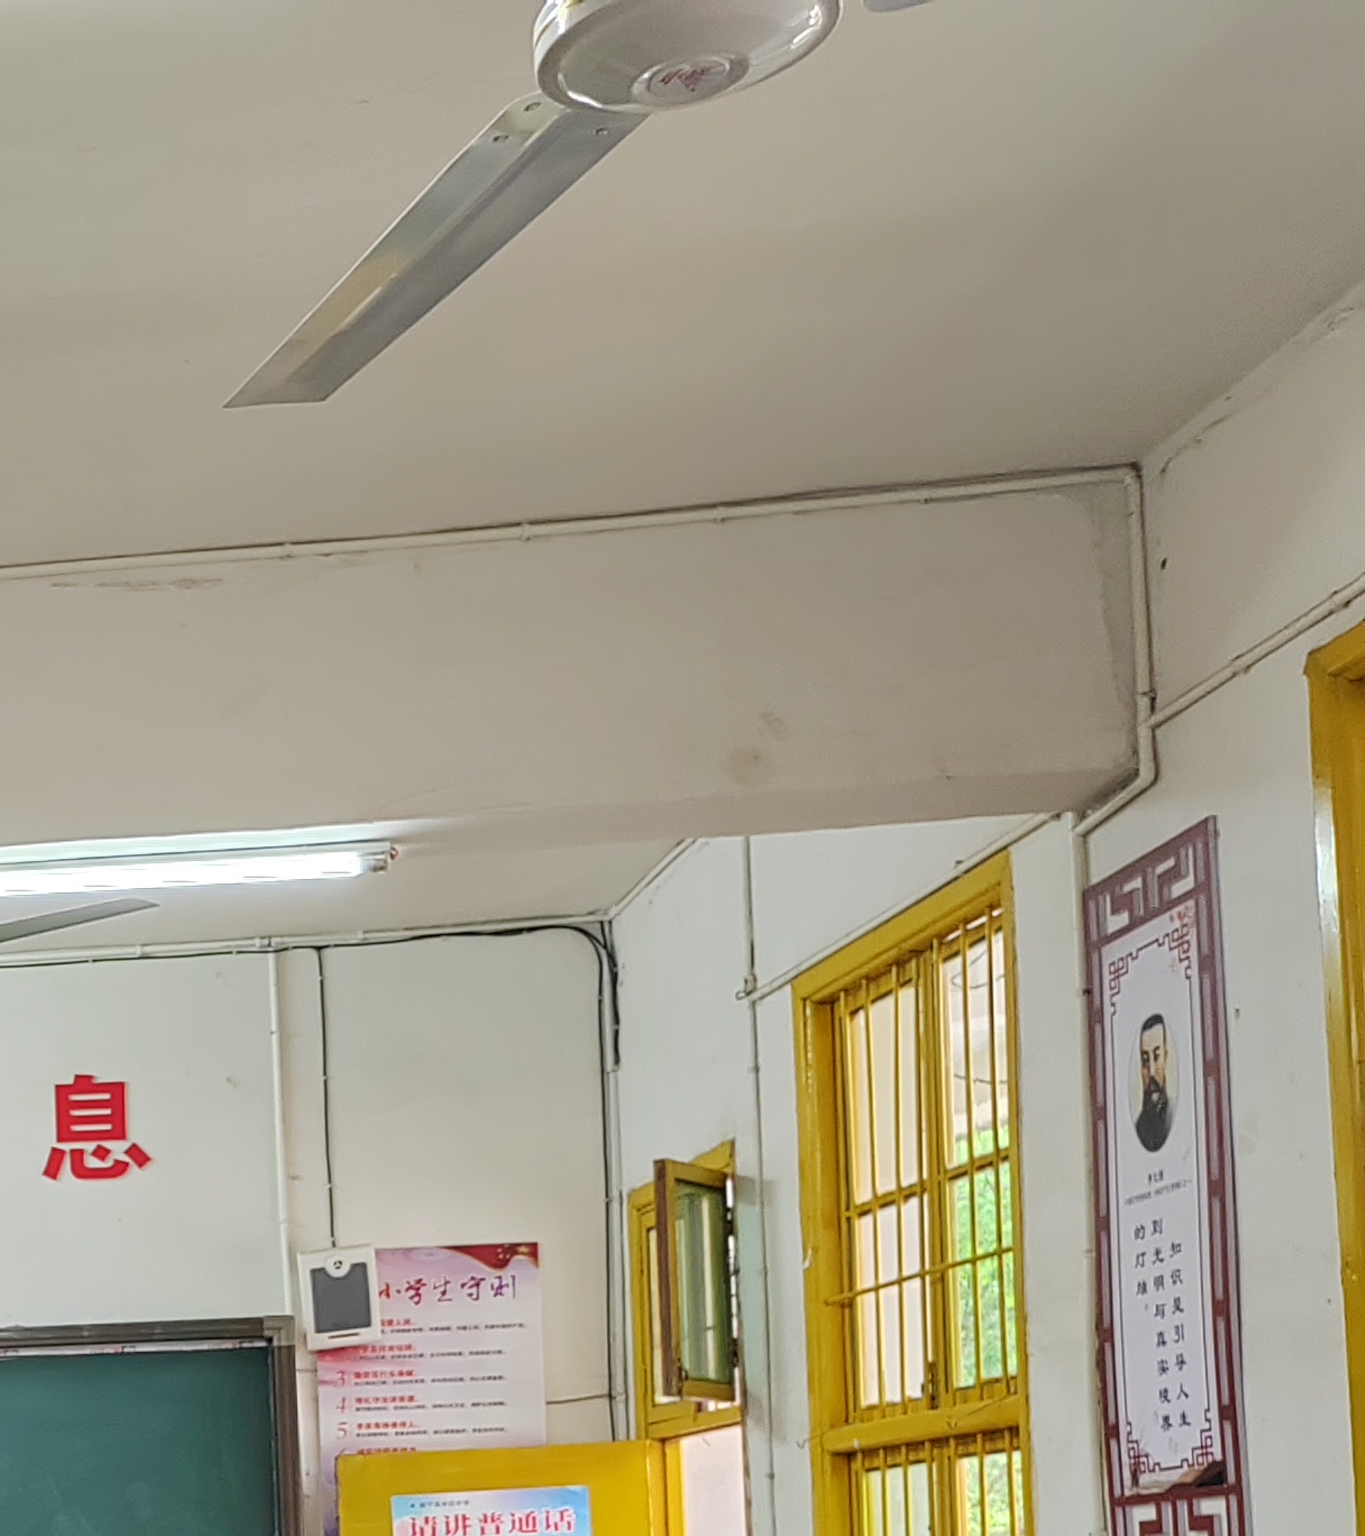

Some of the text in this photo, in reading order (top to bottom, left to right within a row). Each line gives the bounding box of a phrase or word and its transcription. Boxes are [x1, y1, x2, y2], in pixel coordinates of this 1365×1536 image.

[1168, 1239, 1192, 1431] 知识是引导人生
[335, 1422, 348, 1439] 5
